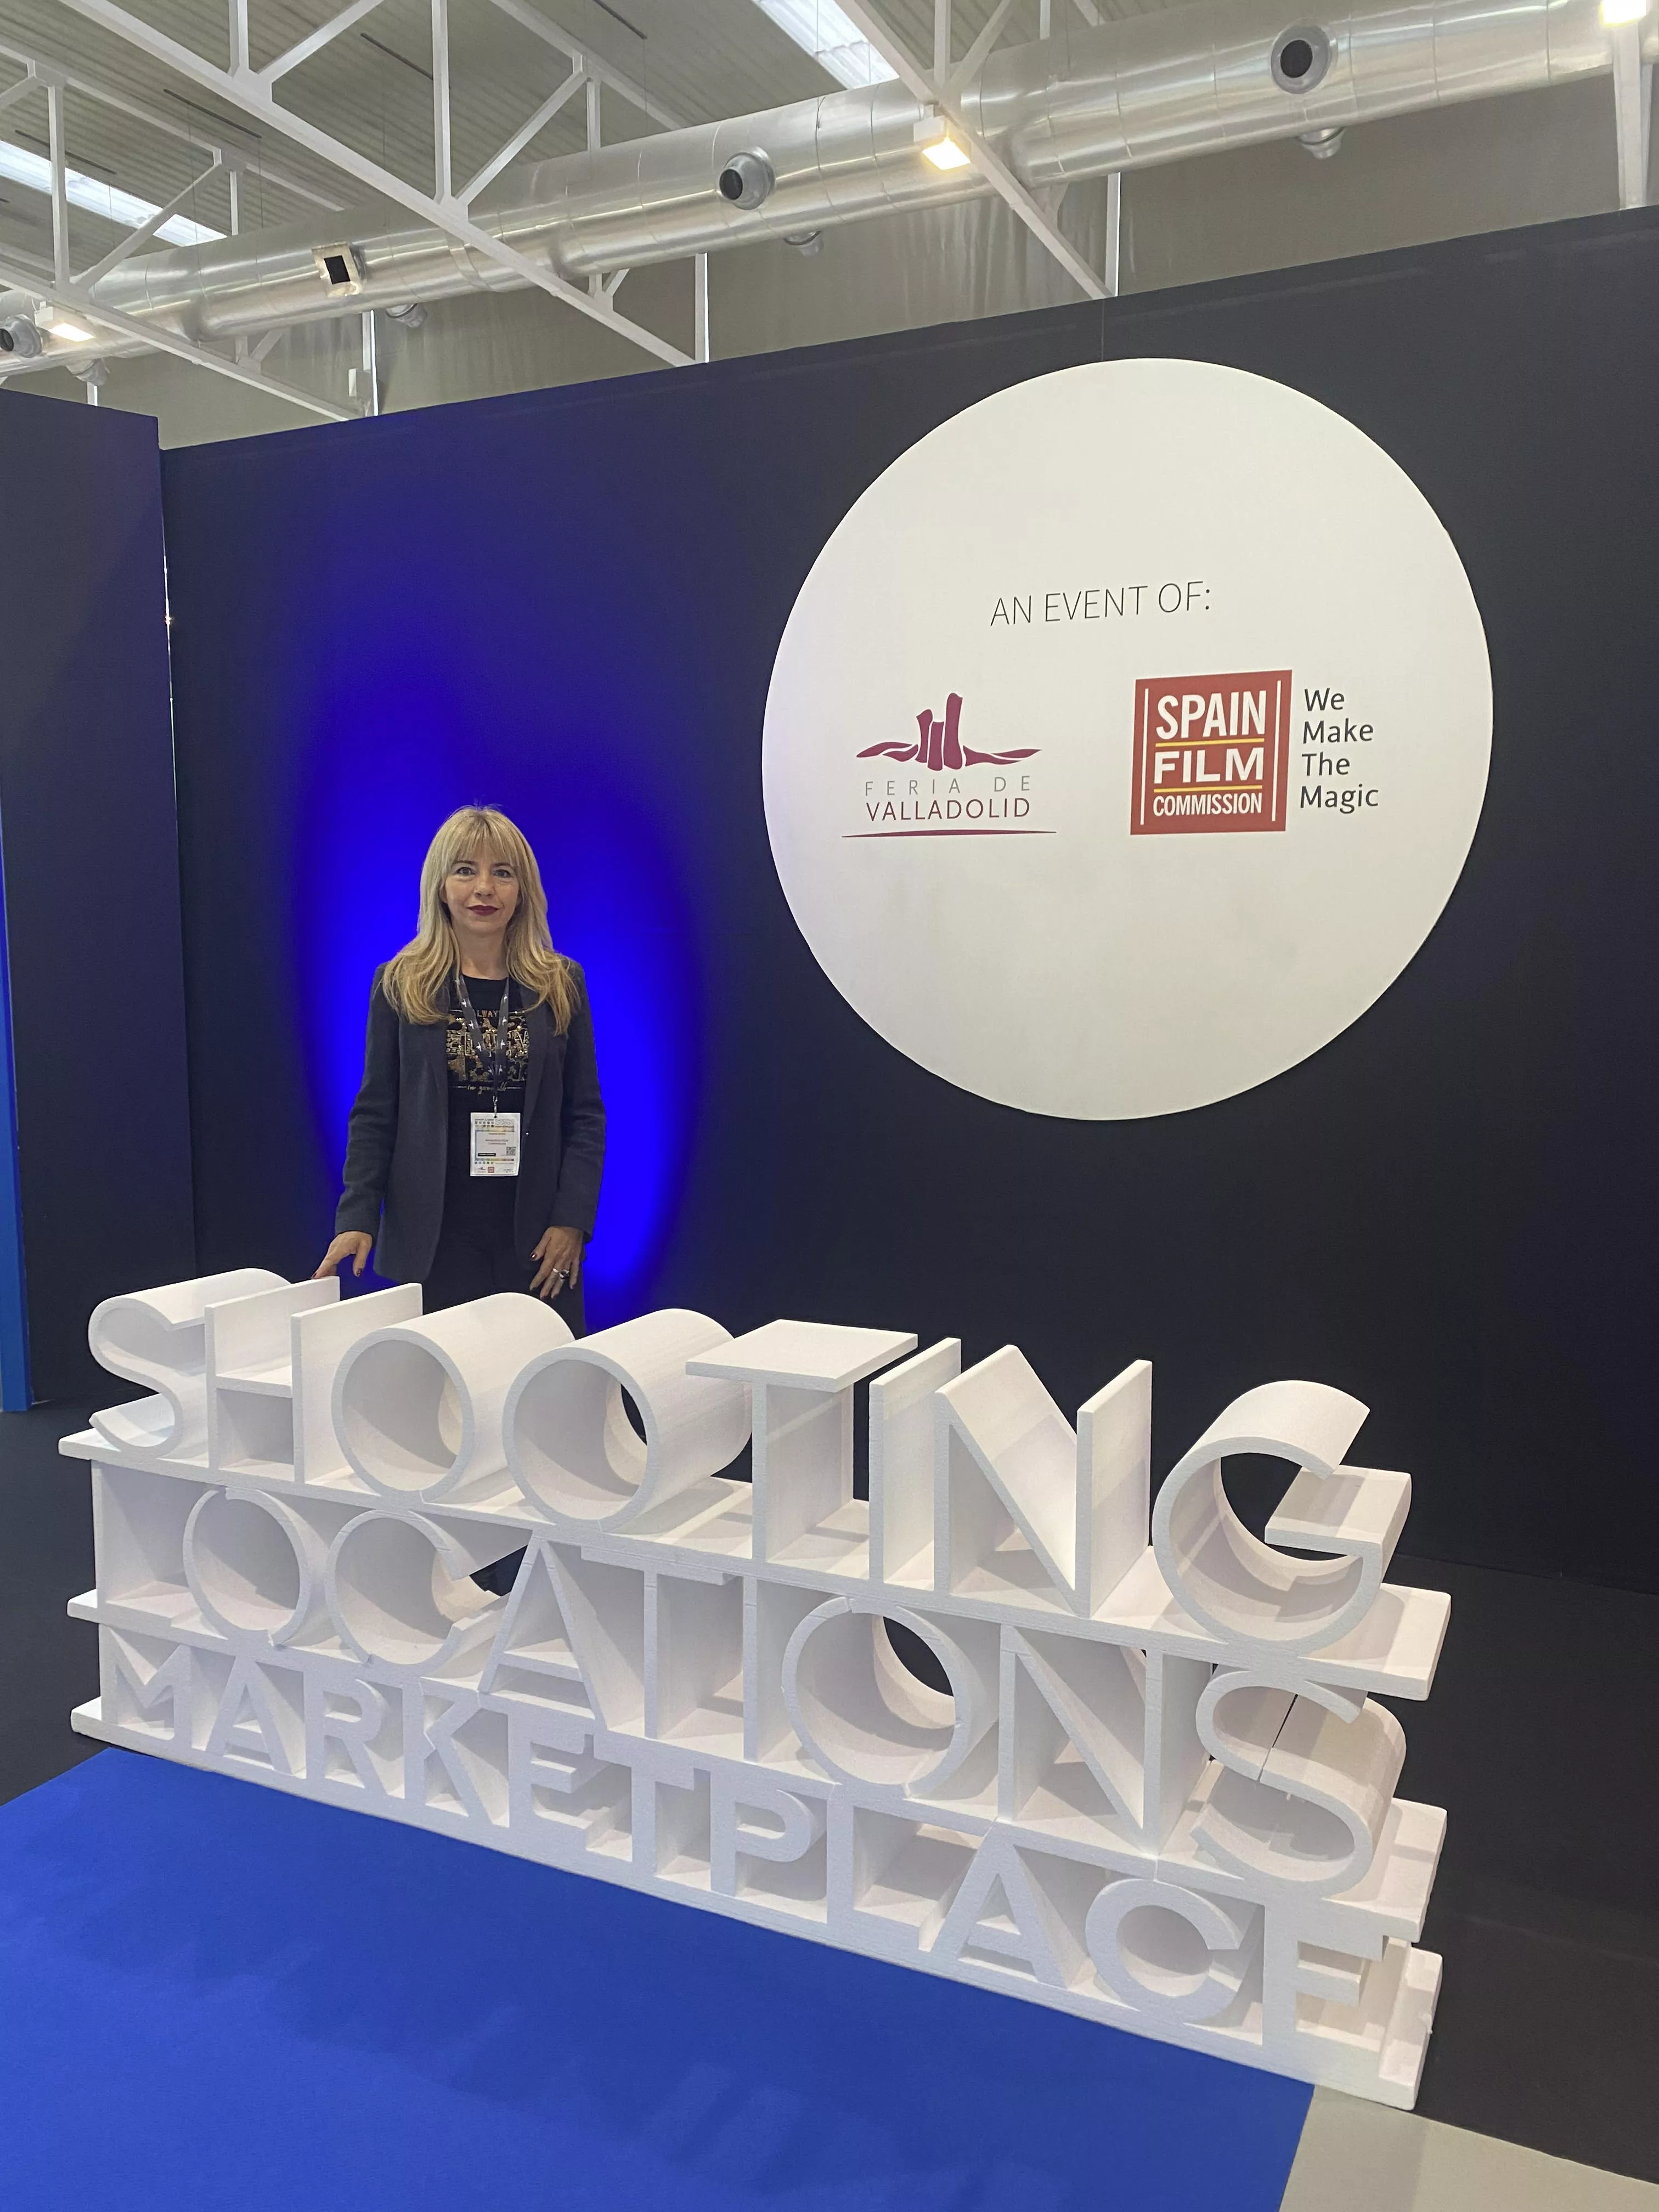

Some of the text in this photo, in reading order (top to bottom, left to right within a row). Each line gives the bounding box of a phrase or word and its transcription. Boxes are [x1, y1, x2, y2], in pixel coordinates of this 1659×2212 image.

[990, 580, 1210, 627] AN EVENT OF:
[1156, 690, 1267, 740] SPAIN
[1304, 687, 1345, 712] We
[1302, 718, 1374, 744] Make
[1154, 747, 1264, 784] FILM
[1301, 751, 1350, 777] The
[865, 775, 1030, 797] FERIA DE
[1300, 783, 1379, 815] Magic
[865, 797, 1030, 822] VALLADOLID
[1153, 792, 1262, 817] COMMISSION
[88, 1268, 1411, 1650] SHOOTING
[91, 1459, 1406, 1883] LOCATIONS
[98, 1622, 1388, 2060] MARKETPLACE
